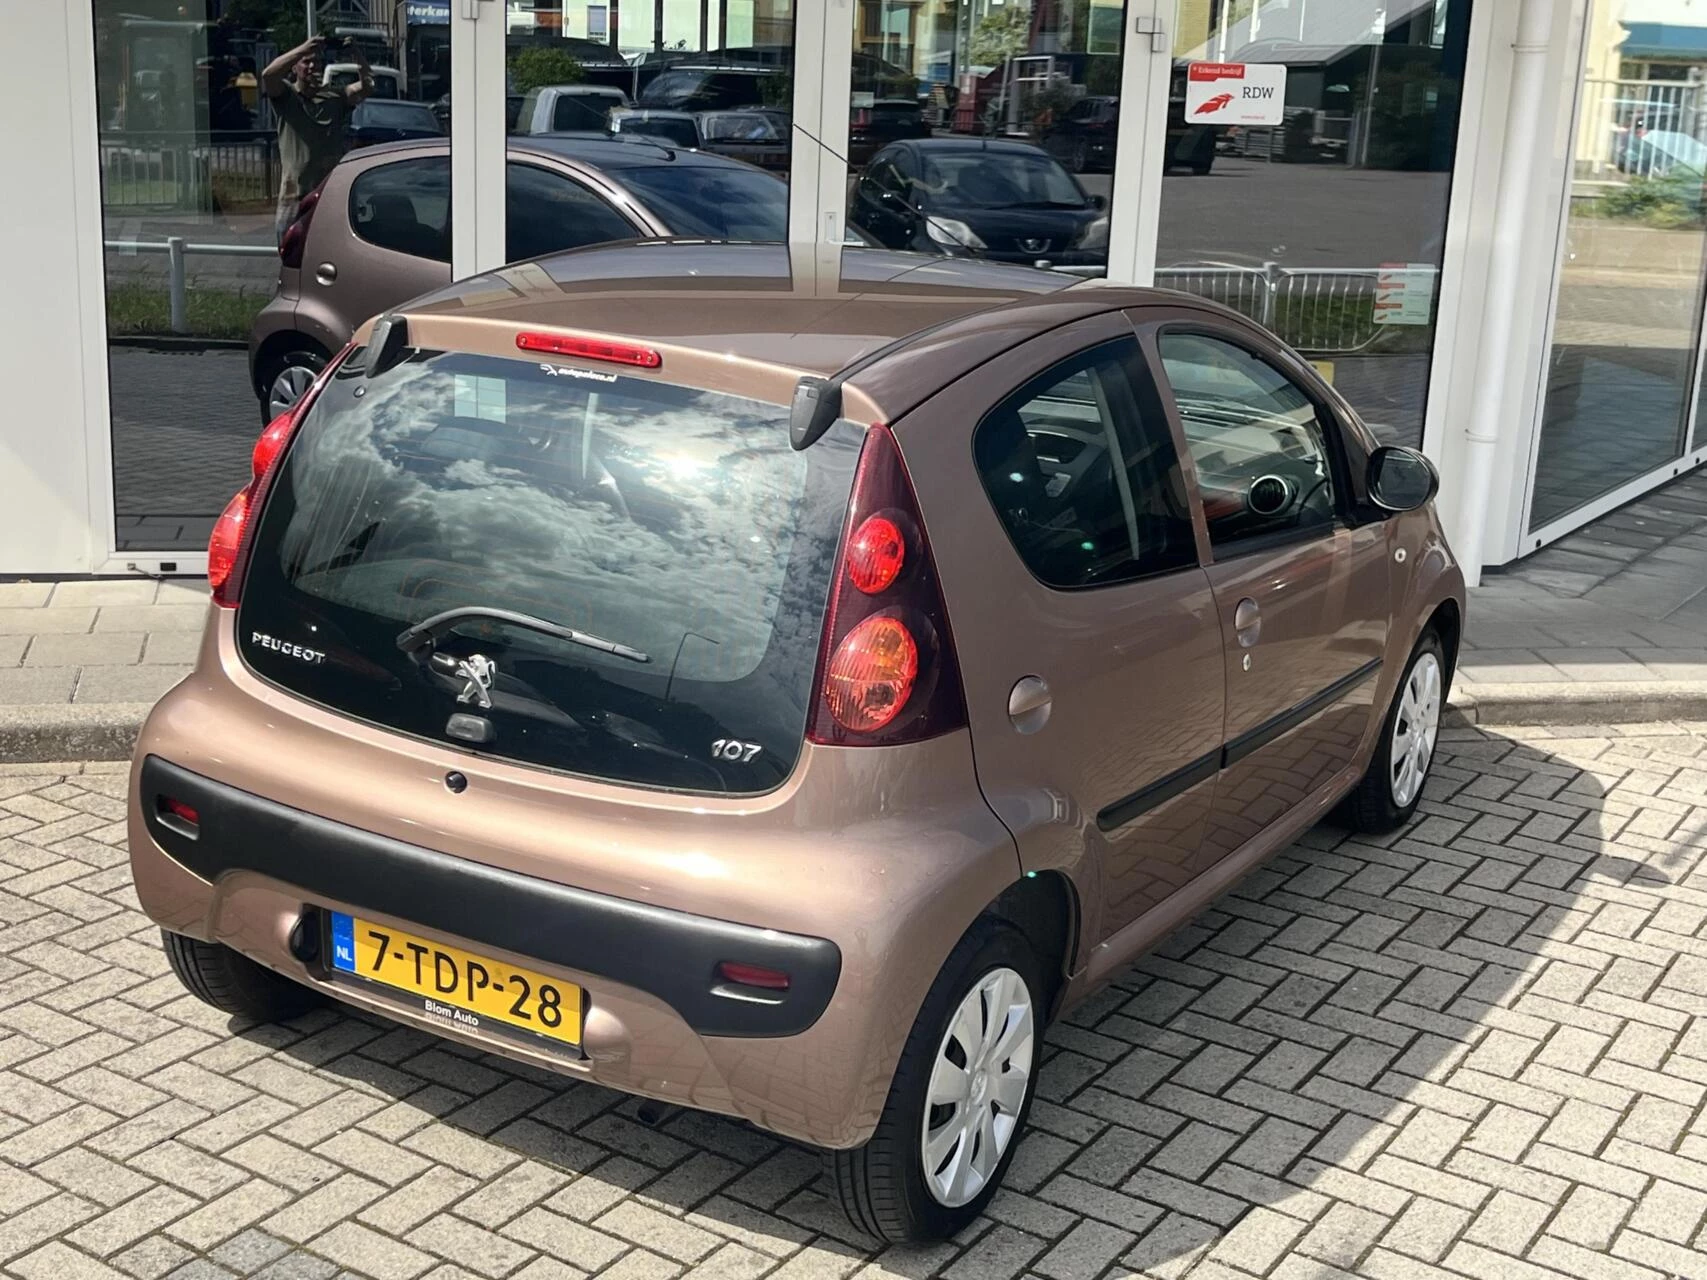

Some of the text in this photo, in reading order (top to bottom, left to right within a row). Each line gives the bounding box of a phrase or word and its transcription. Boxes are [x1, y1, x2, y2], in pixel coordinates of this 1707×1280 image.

[1242, 87, 1274, 99] RDW
[251, 632, 326, 664] PEUGEOT
[711, 739, 762, 762] 107
[336, 945, 353, 962] NL
[368, 931, 562, 1028] 7-TDP-28
[425, 999, 479, 1026] Blom Auto
